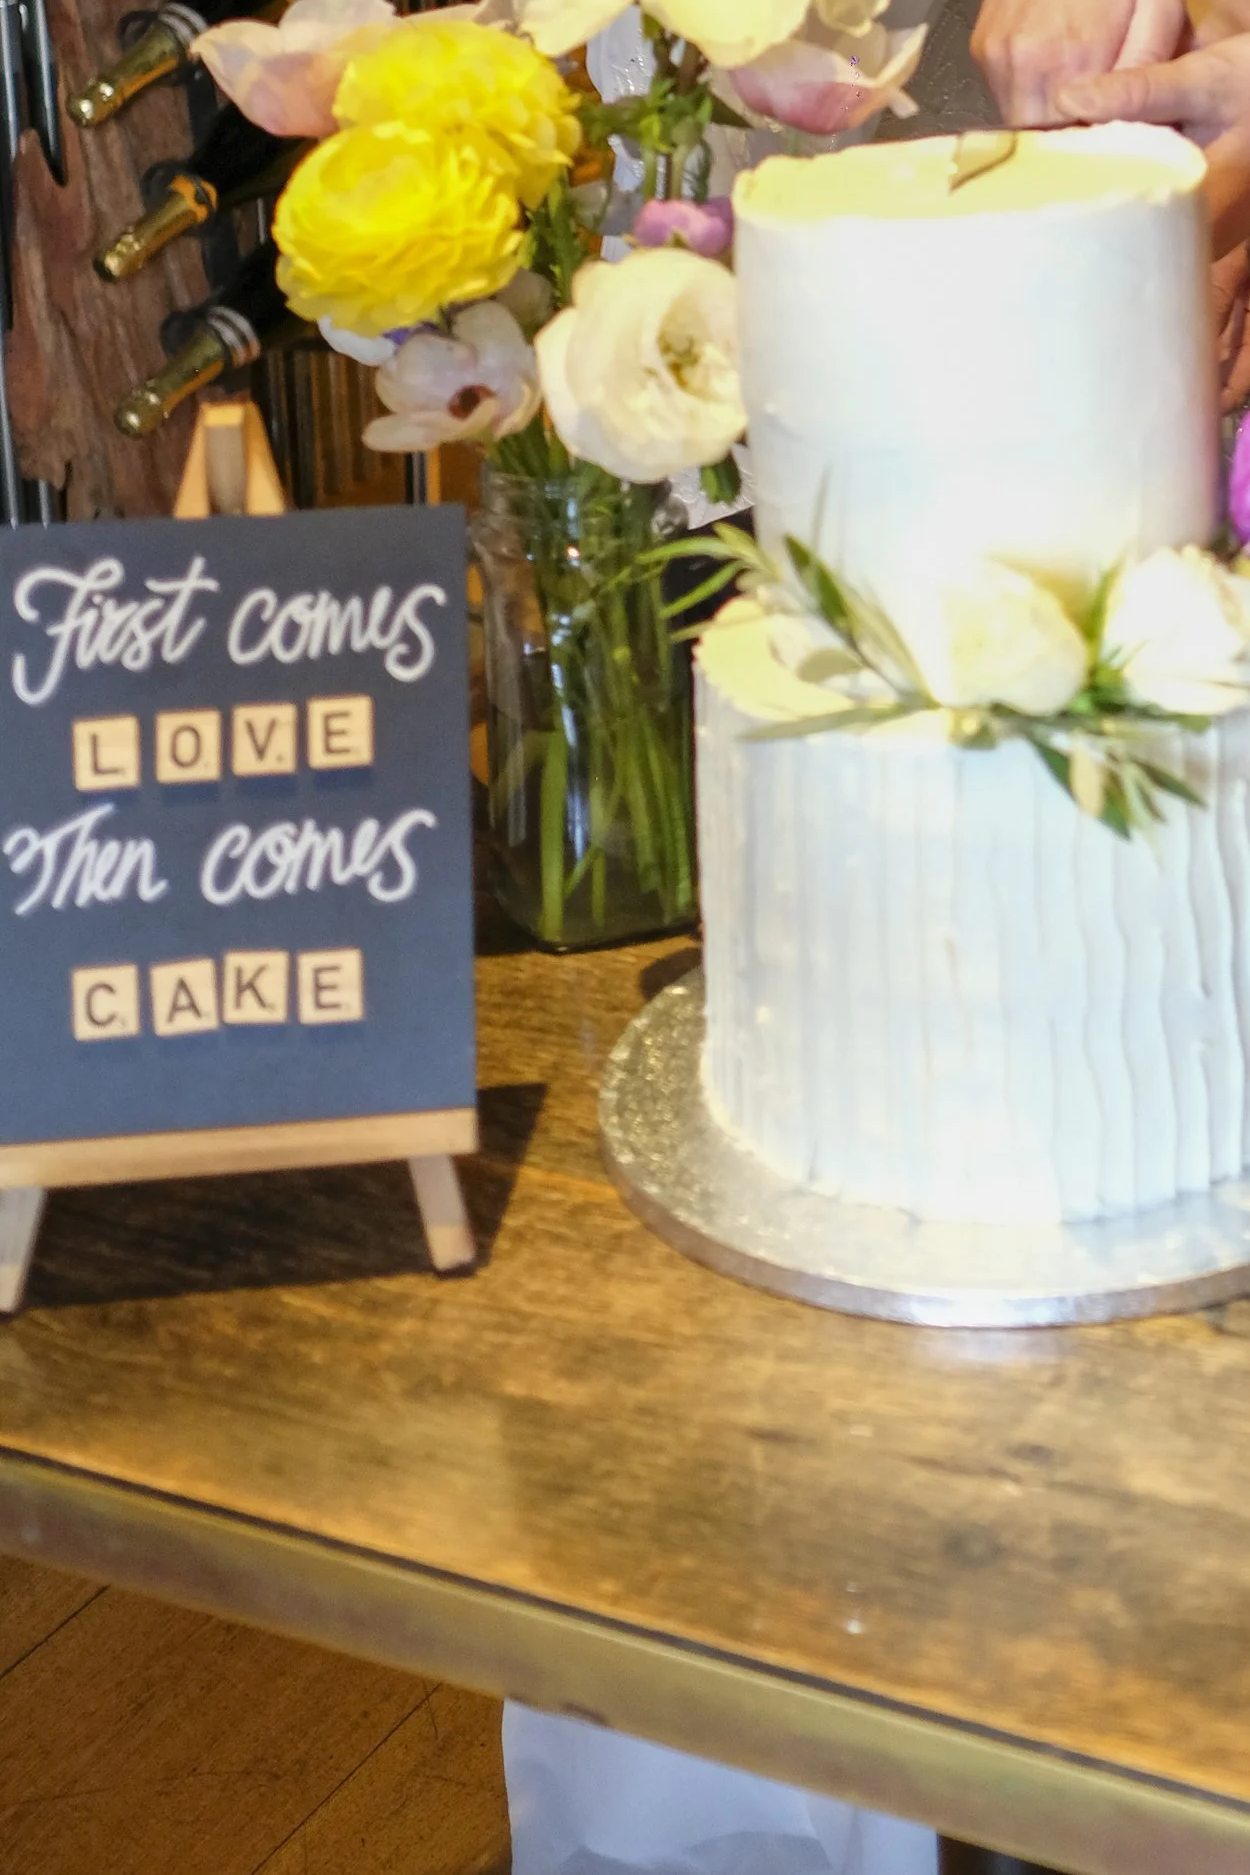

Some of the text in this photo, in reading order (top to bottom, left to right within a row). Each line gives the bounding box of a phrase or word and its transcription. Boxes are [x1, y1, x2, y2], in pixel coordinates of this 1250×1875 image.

[12, 556, 446, 706] First comes
[89, 710, 353, 777] LOVE
[3, 802, 437, 916] Then comes
[84, 963, 343, 1028] CAKE
